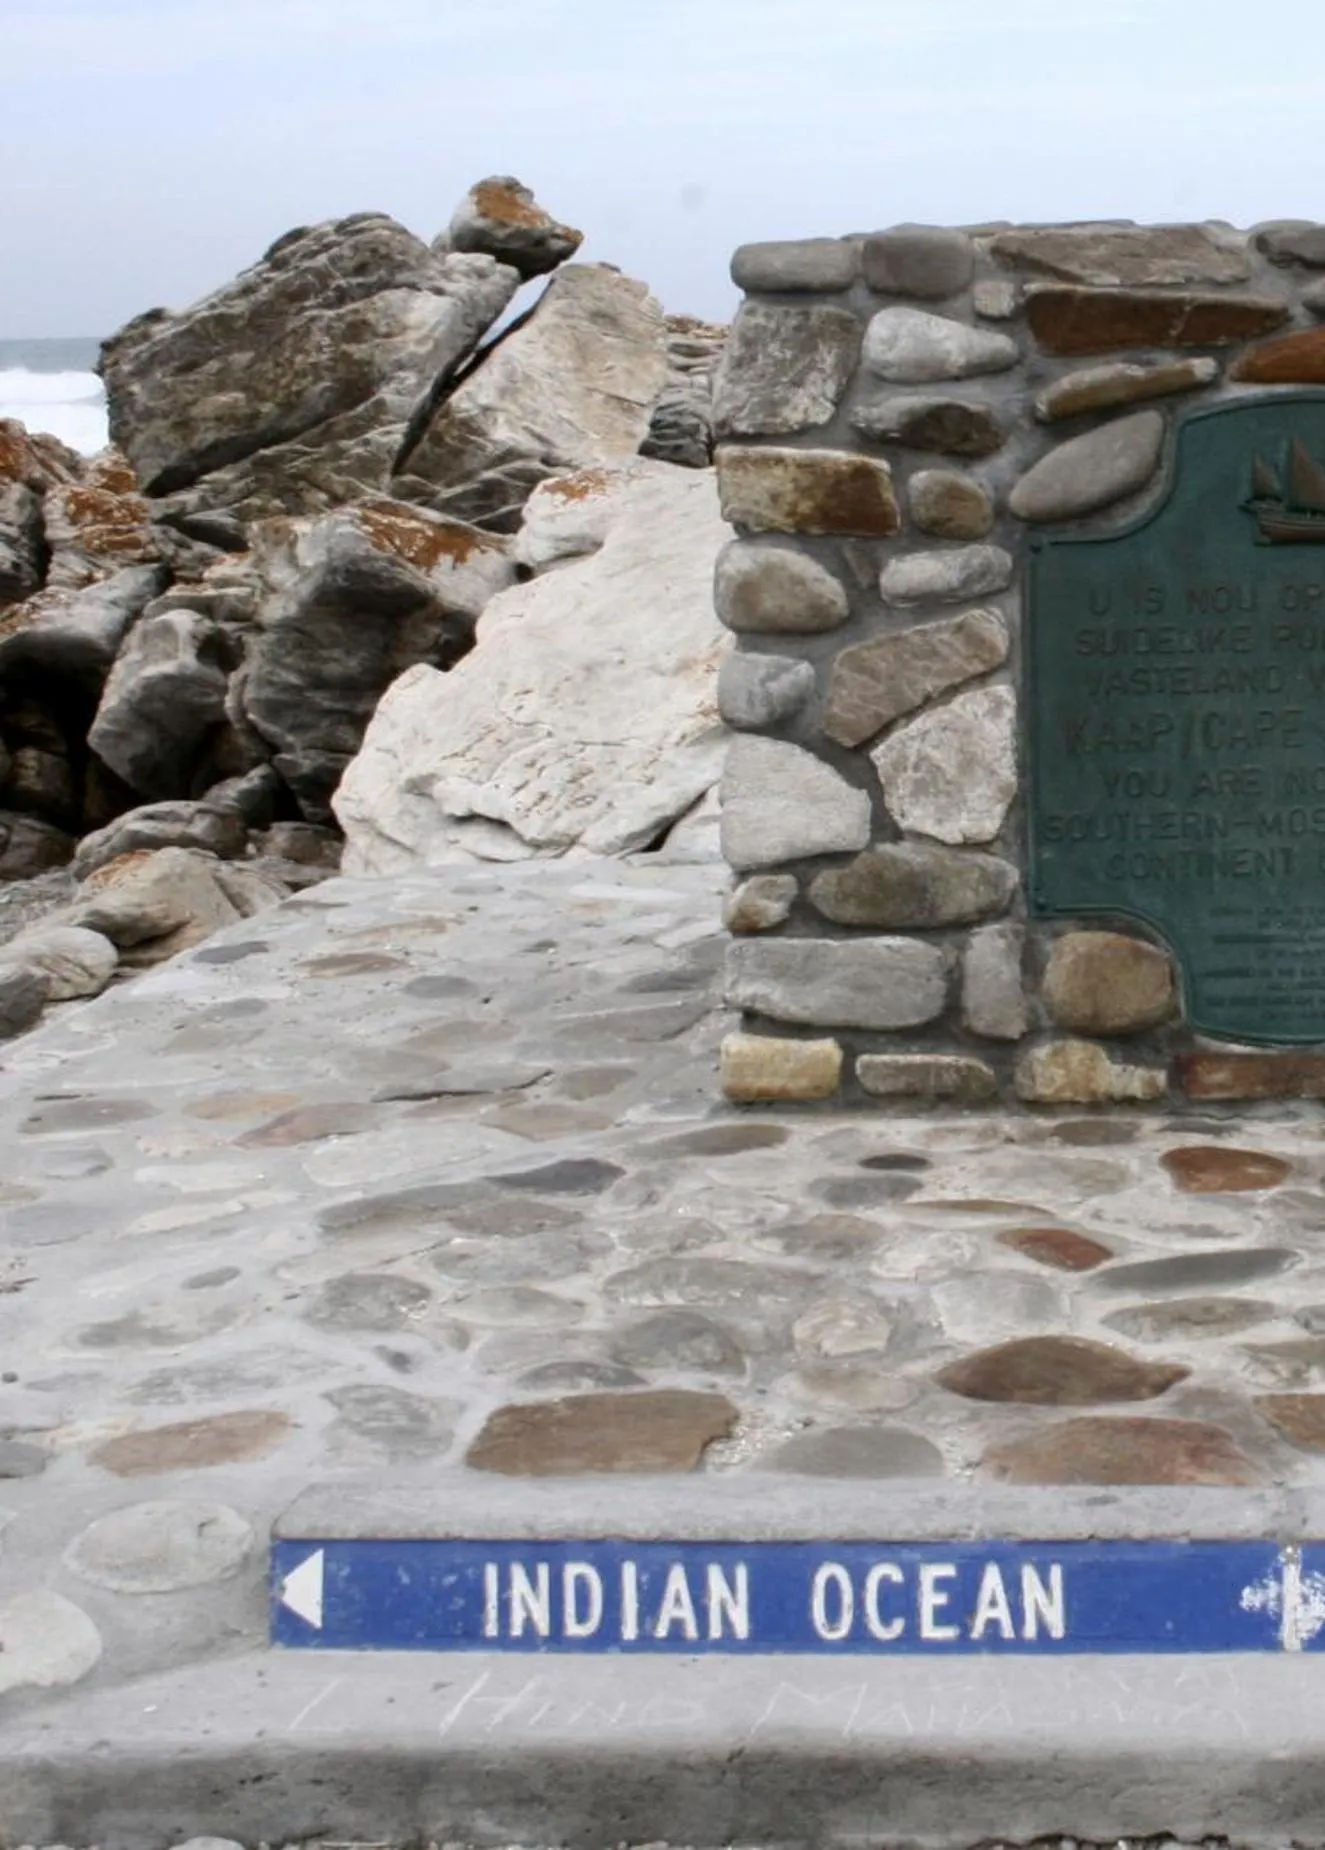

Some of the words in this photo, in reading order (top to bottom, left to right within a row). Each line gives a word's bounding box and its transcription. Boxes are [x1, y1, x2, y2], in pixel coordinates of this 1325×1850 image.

[1186, 582, 1258, 615] NOU
[1281, 582, 1323, 613] OP
[1085, 665, 1285, 698] VASTELAND
[1102, 768, 1172, 799] YOU
[1190, 766, 1264, 798] ARE
[1106, 846, 1294, 882] CONTINENT
[483, 1560, 751, 1640] INDIAN
[810, 1561, 1066, 1641] OCEAN
